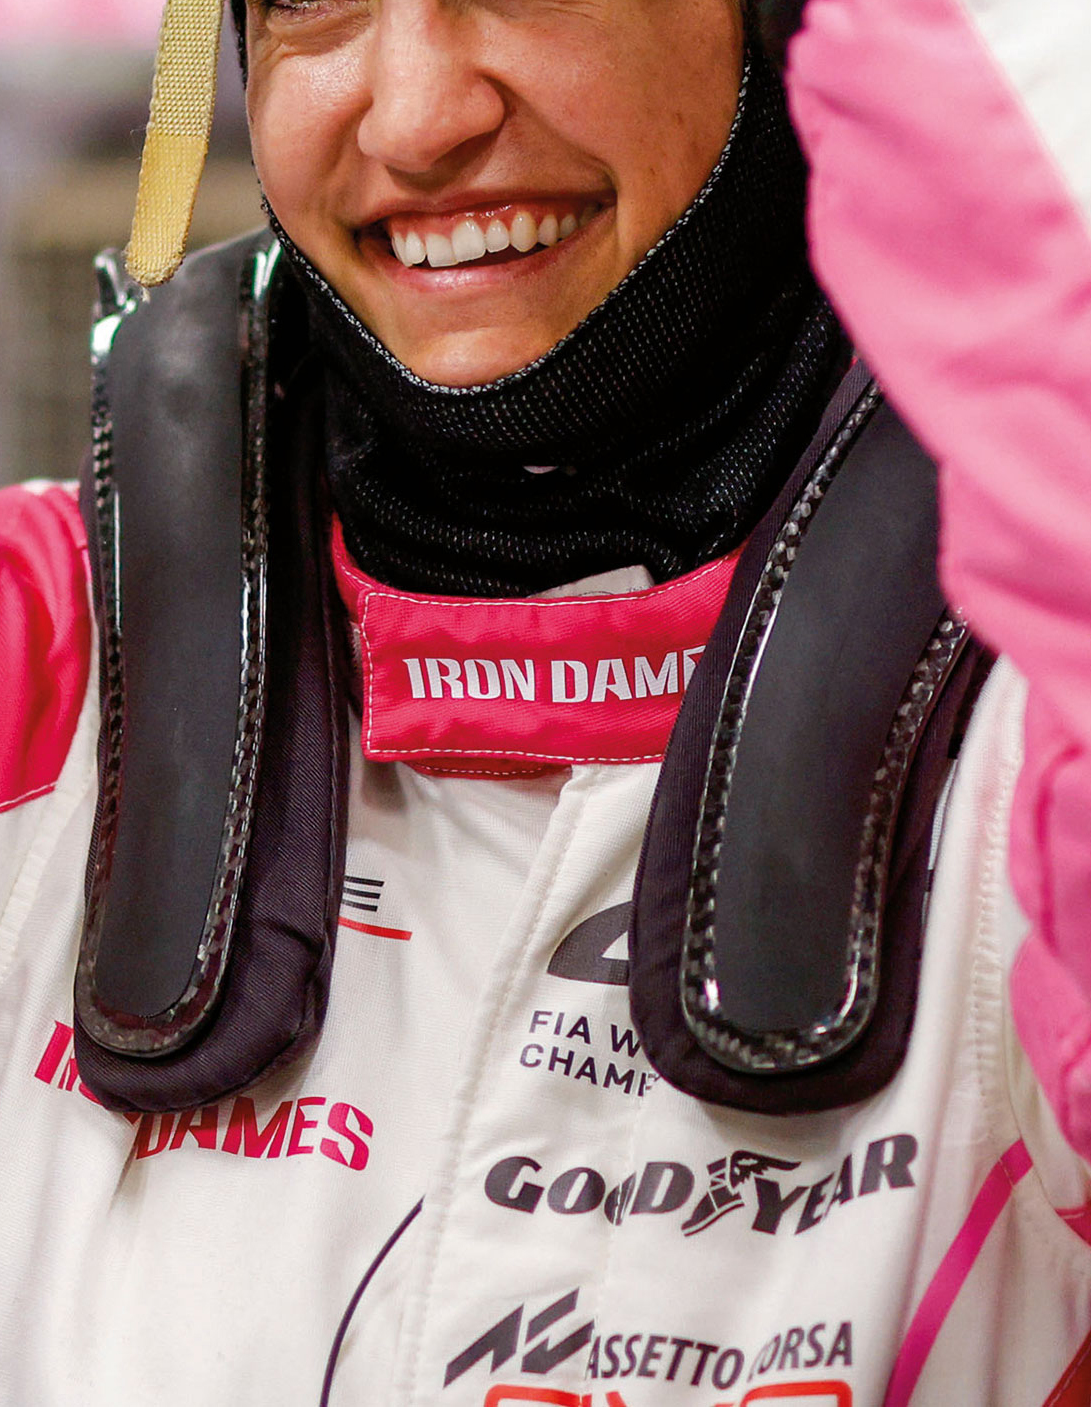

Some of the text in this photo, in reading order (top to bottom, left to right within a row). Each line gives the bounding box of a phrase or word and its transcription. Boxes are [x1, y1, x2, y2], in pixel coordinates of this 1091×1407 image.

[402, 657, 536, 702] IRON
[528, 1009, 592, 1046] FIA
[519, 1042, 661, 1098] CHAMP
[135, 1095, 375, 1172] DAMES
[584, 1328, 746, 1392] ASSETTO
